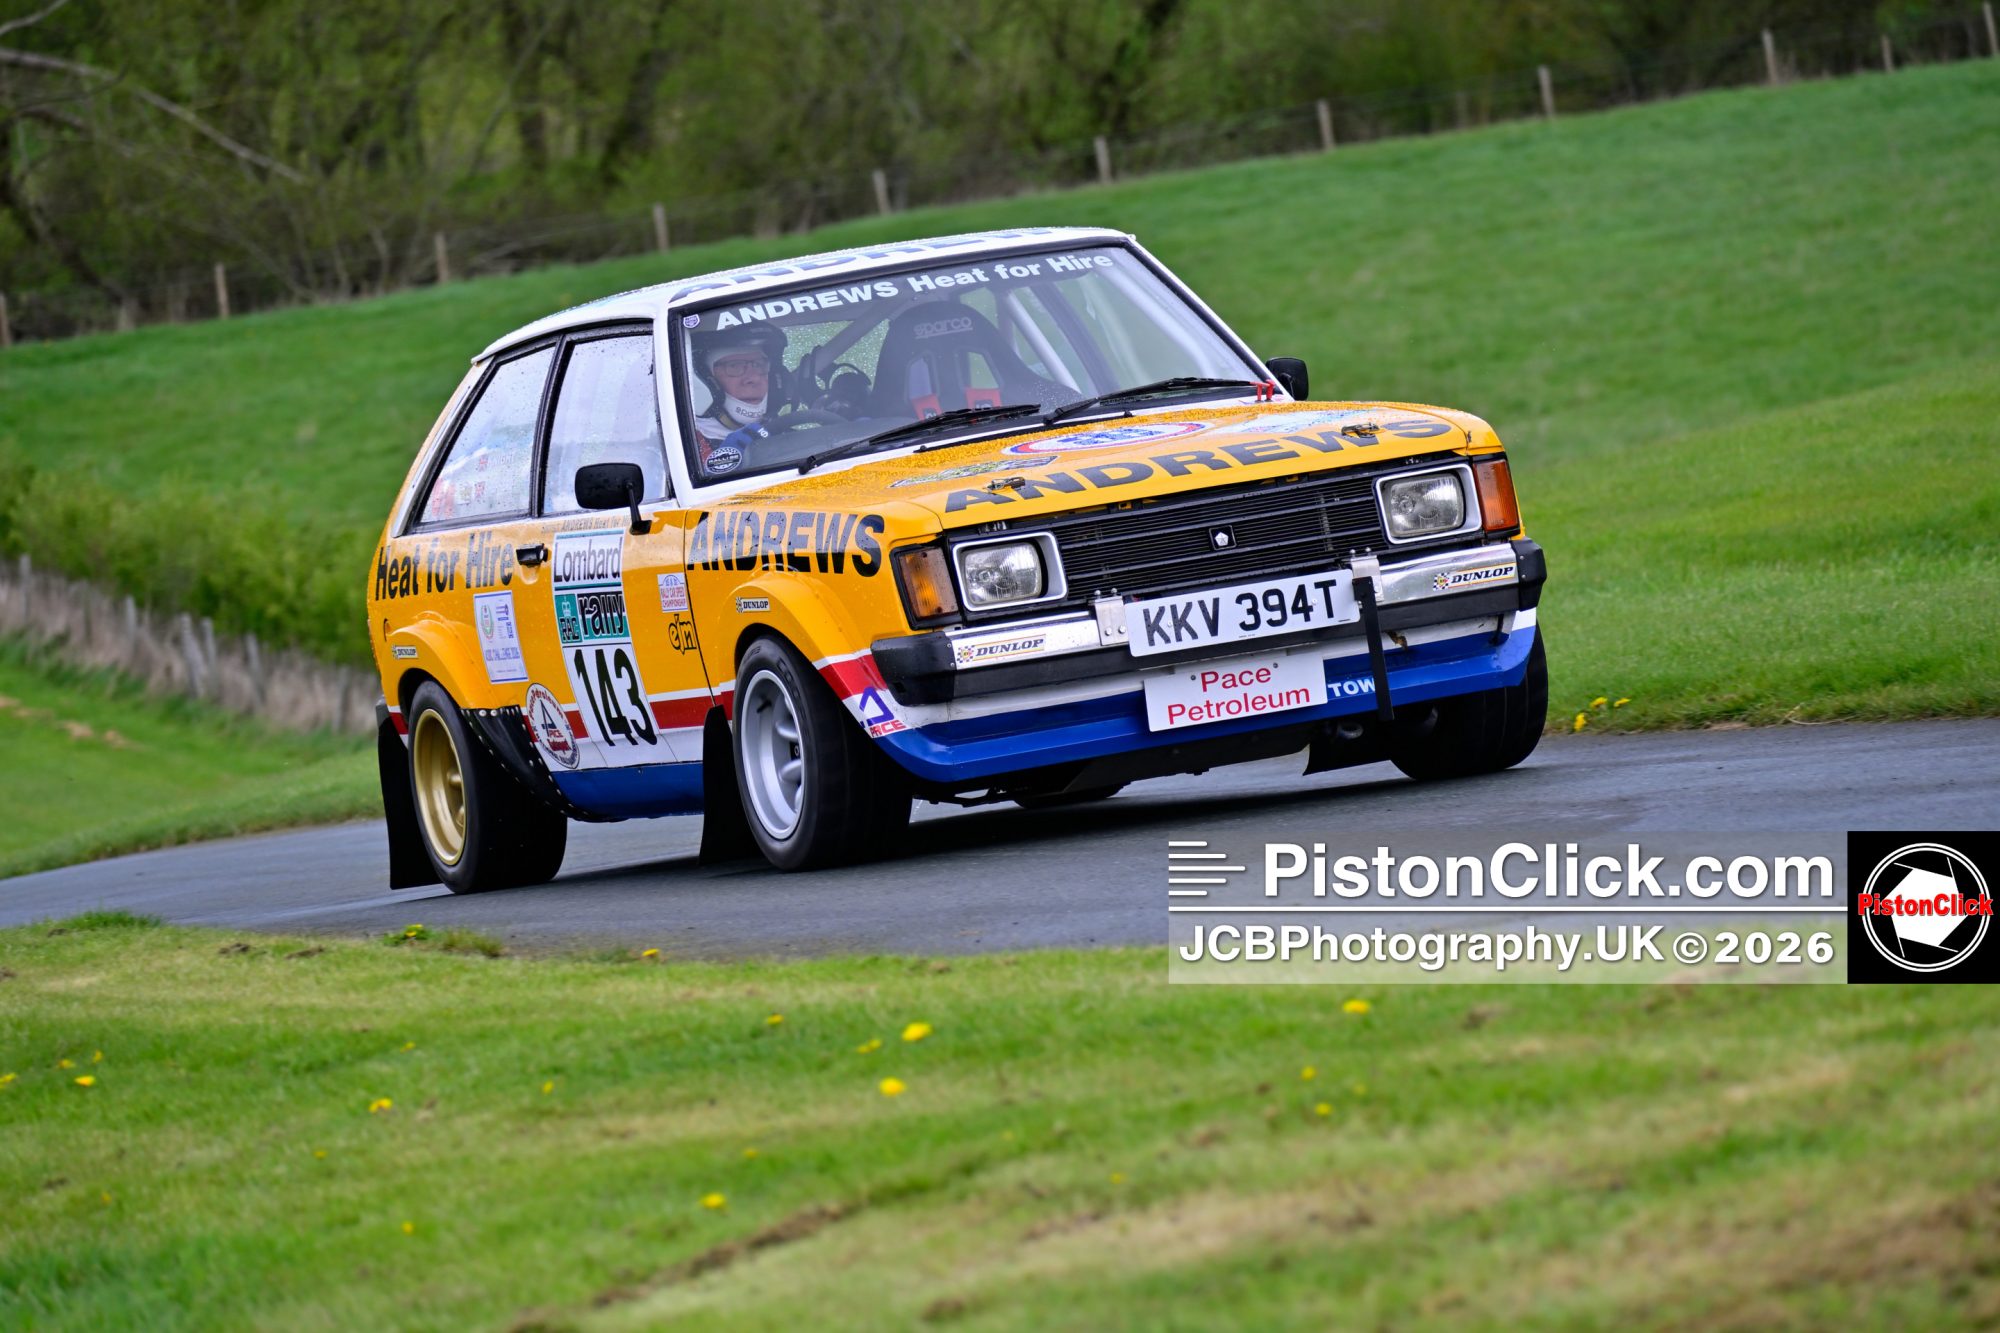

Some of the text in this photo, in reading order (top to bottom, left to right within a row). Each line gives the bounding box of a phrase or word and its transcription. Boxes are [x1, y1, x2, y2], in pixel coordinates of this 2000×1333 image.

[716, 281, 899, 331] ANDREWS
[906, 267, 989, 292] Heat
[994, 263, 1041, 280] for
[1045, 255, 1114, 273] Hire
[913, 316, 972, 335] sparco
[944, 419, 1452, 513] ANDREWS
[375, 530, 514, 601] Heat for Hire
[553, 537, 623, 583] Lombard
[687, 511, 885, 577] ANDREWS
[1451, 566, 1514, 583] DUNLOP
[560, 594, 626, 643] RAC rally
[743, 600, 769, 609] DUNLOP
[1143, 579, 1337, 647] KKV 394T
[975, 638, 1044, 657] DUNLOP
[574, 648, 658, 747] 143
[1200, 667, 1272, 693] Pace
[1328, 677, 1376, 698] TOW
[1167, 687, 1311, 725] Petroleum
